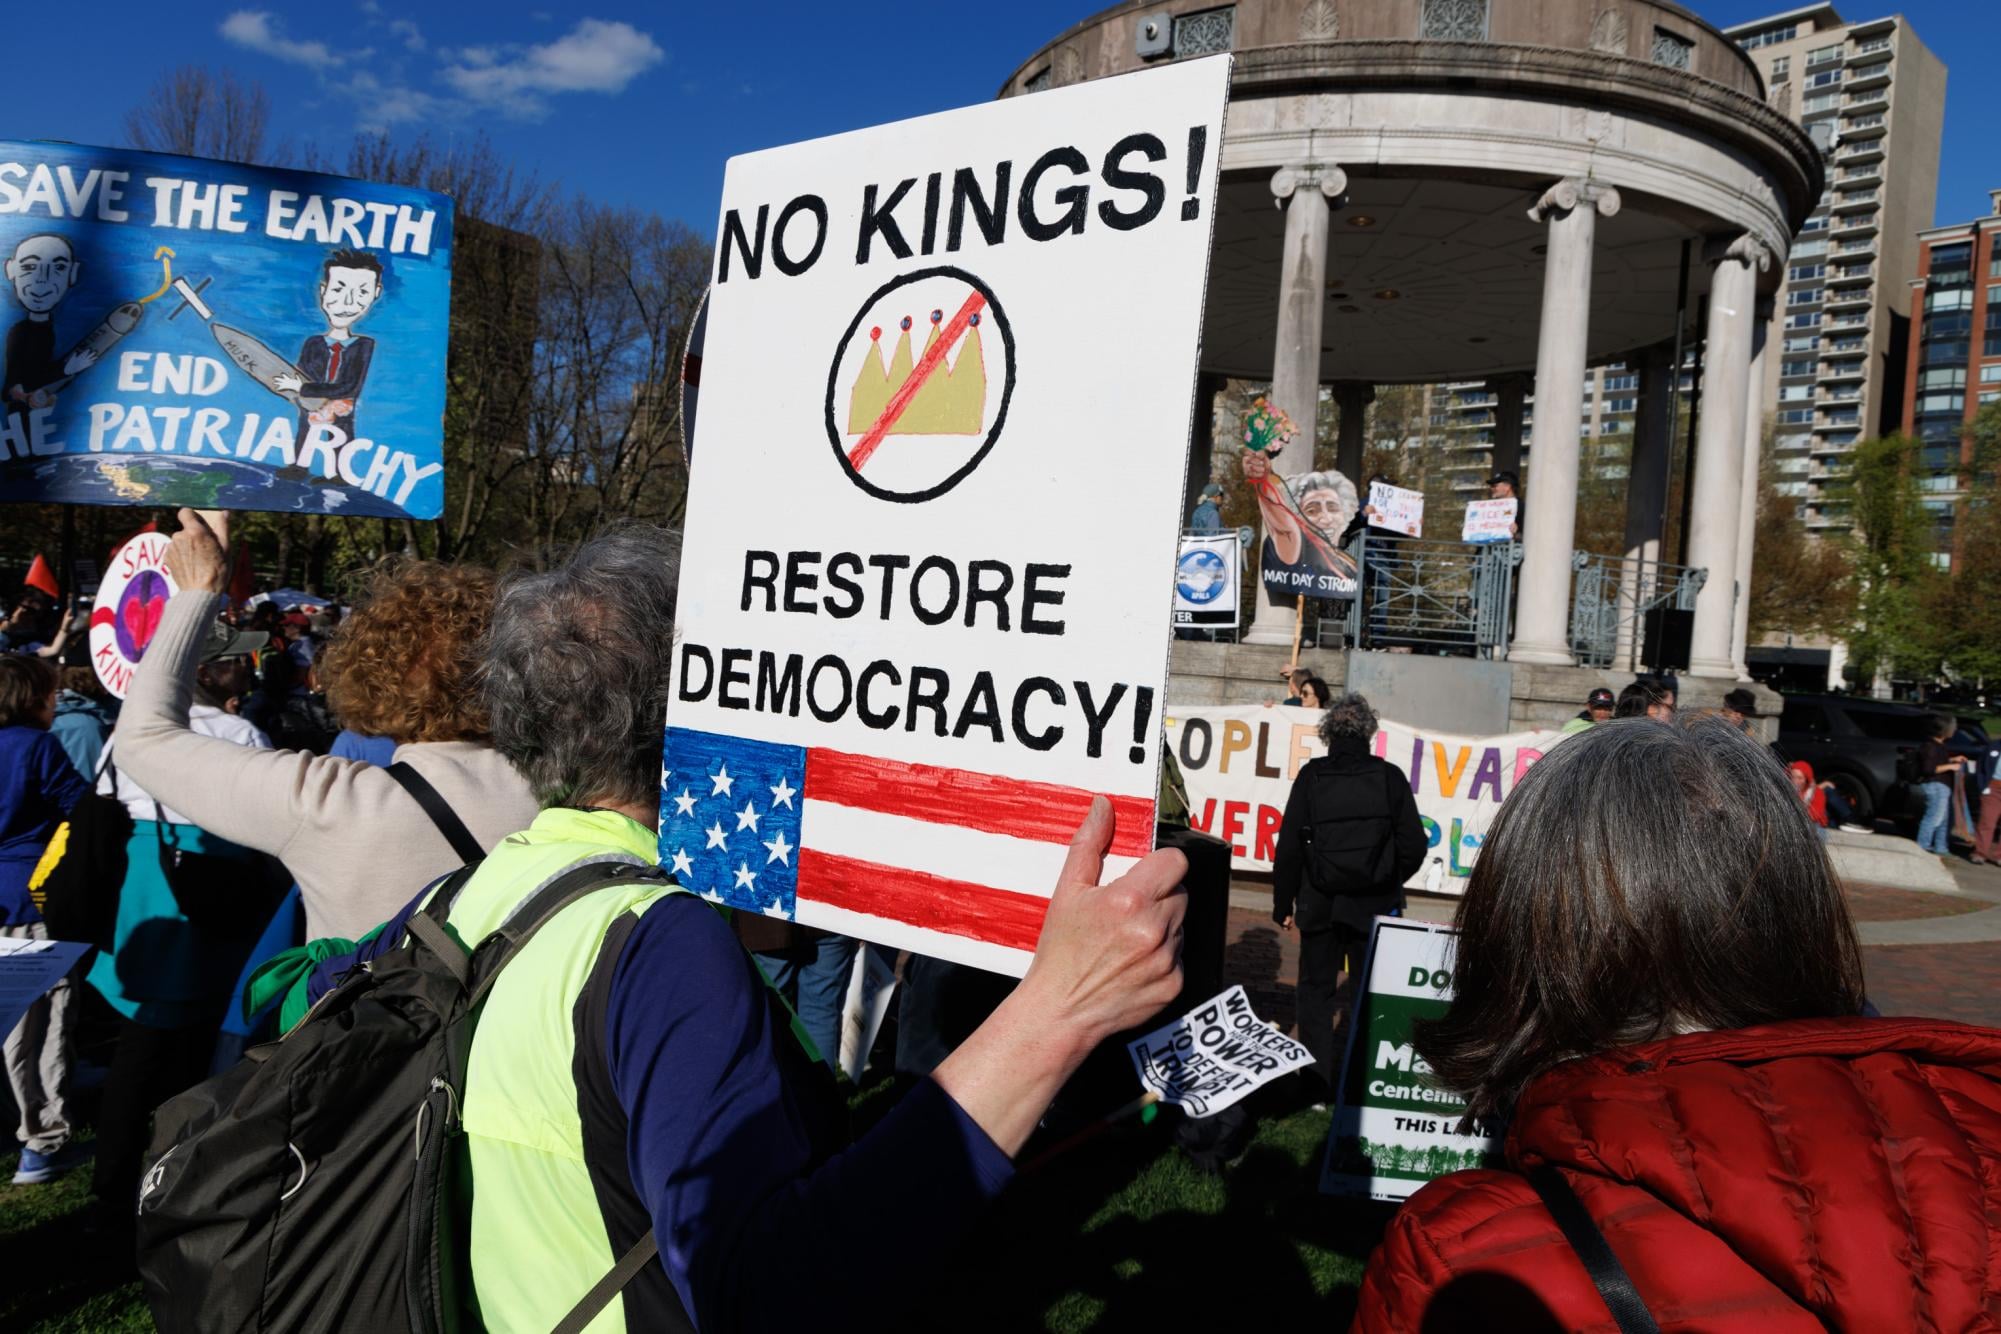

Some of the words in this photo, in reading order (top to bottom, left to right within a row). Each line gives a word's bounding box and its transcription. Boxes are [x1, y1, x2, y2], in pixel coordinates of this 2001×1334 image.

[0, 162, 130, 222] SAVE
[146, 177, 249, 233] THE
[265, 189, 436, 256] EARTH
[717, 193, 828, 284] NO
[855, 124, 1207, 266] KINGS!
[117, 351, 229, 397] END
[224, 341, 257, 372] MUSK
[88, 402, 444, 506] PATRIARCHY
[122, 538, 172, 580] SAV
[1264, 569, 1289, 584] MAY
[1291, 572, 1315, 588] DAY
[741, 550, 1071, 635] RESTORE
[678, 644, 1154, 764] DEMOCRACY!
[1166, 717, 1320, 781] OPLE
[1172, 1022, 1193, 1051] TO
[1194, 1004, 1279, 1075] POWER
[1226, 990, 1306, 1061] WORKERS
[1183, 1052, 1252, 1092] DEFEAT
[1394, 1117, 1437, 1134] THIS
